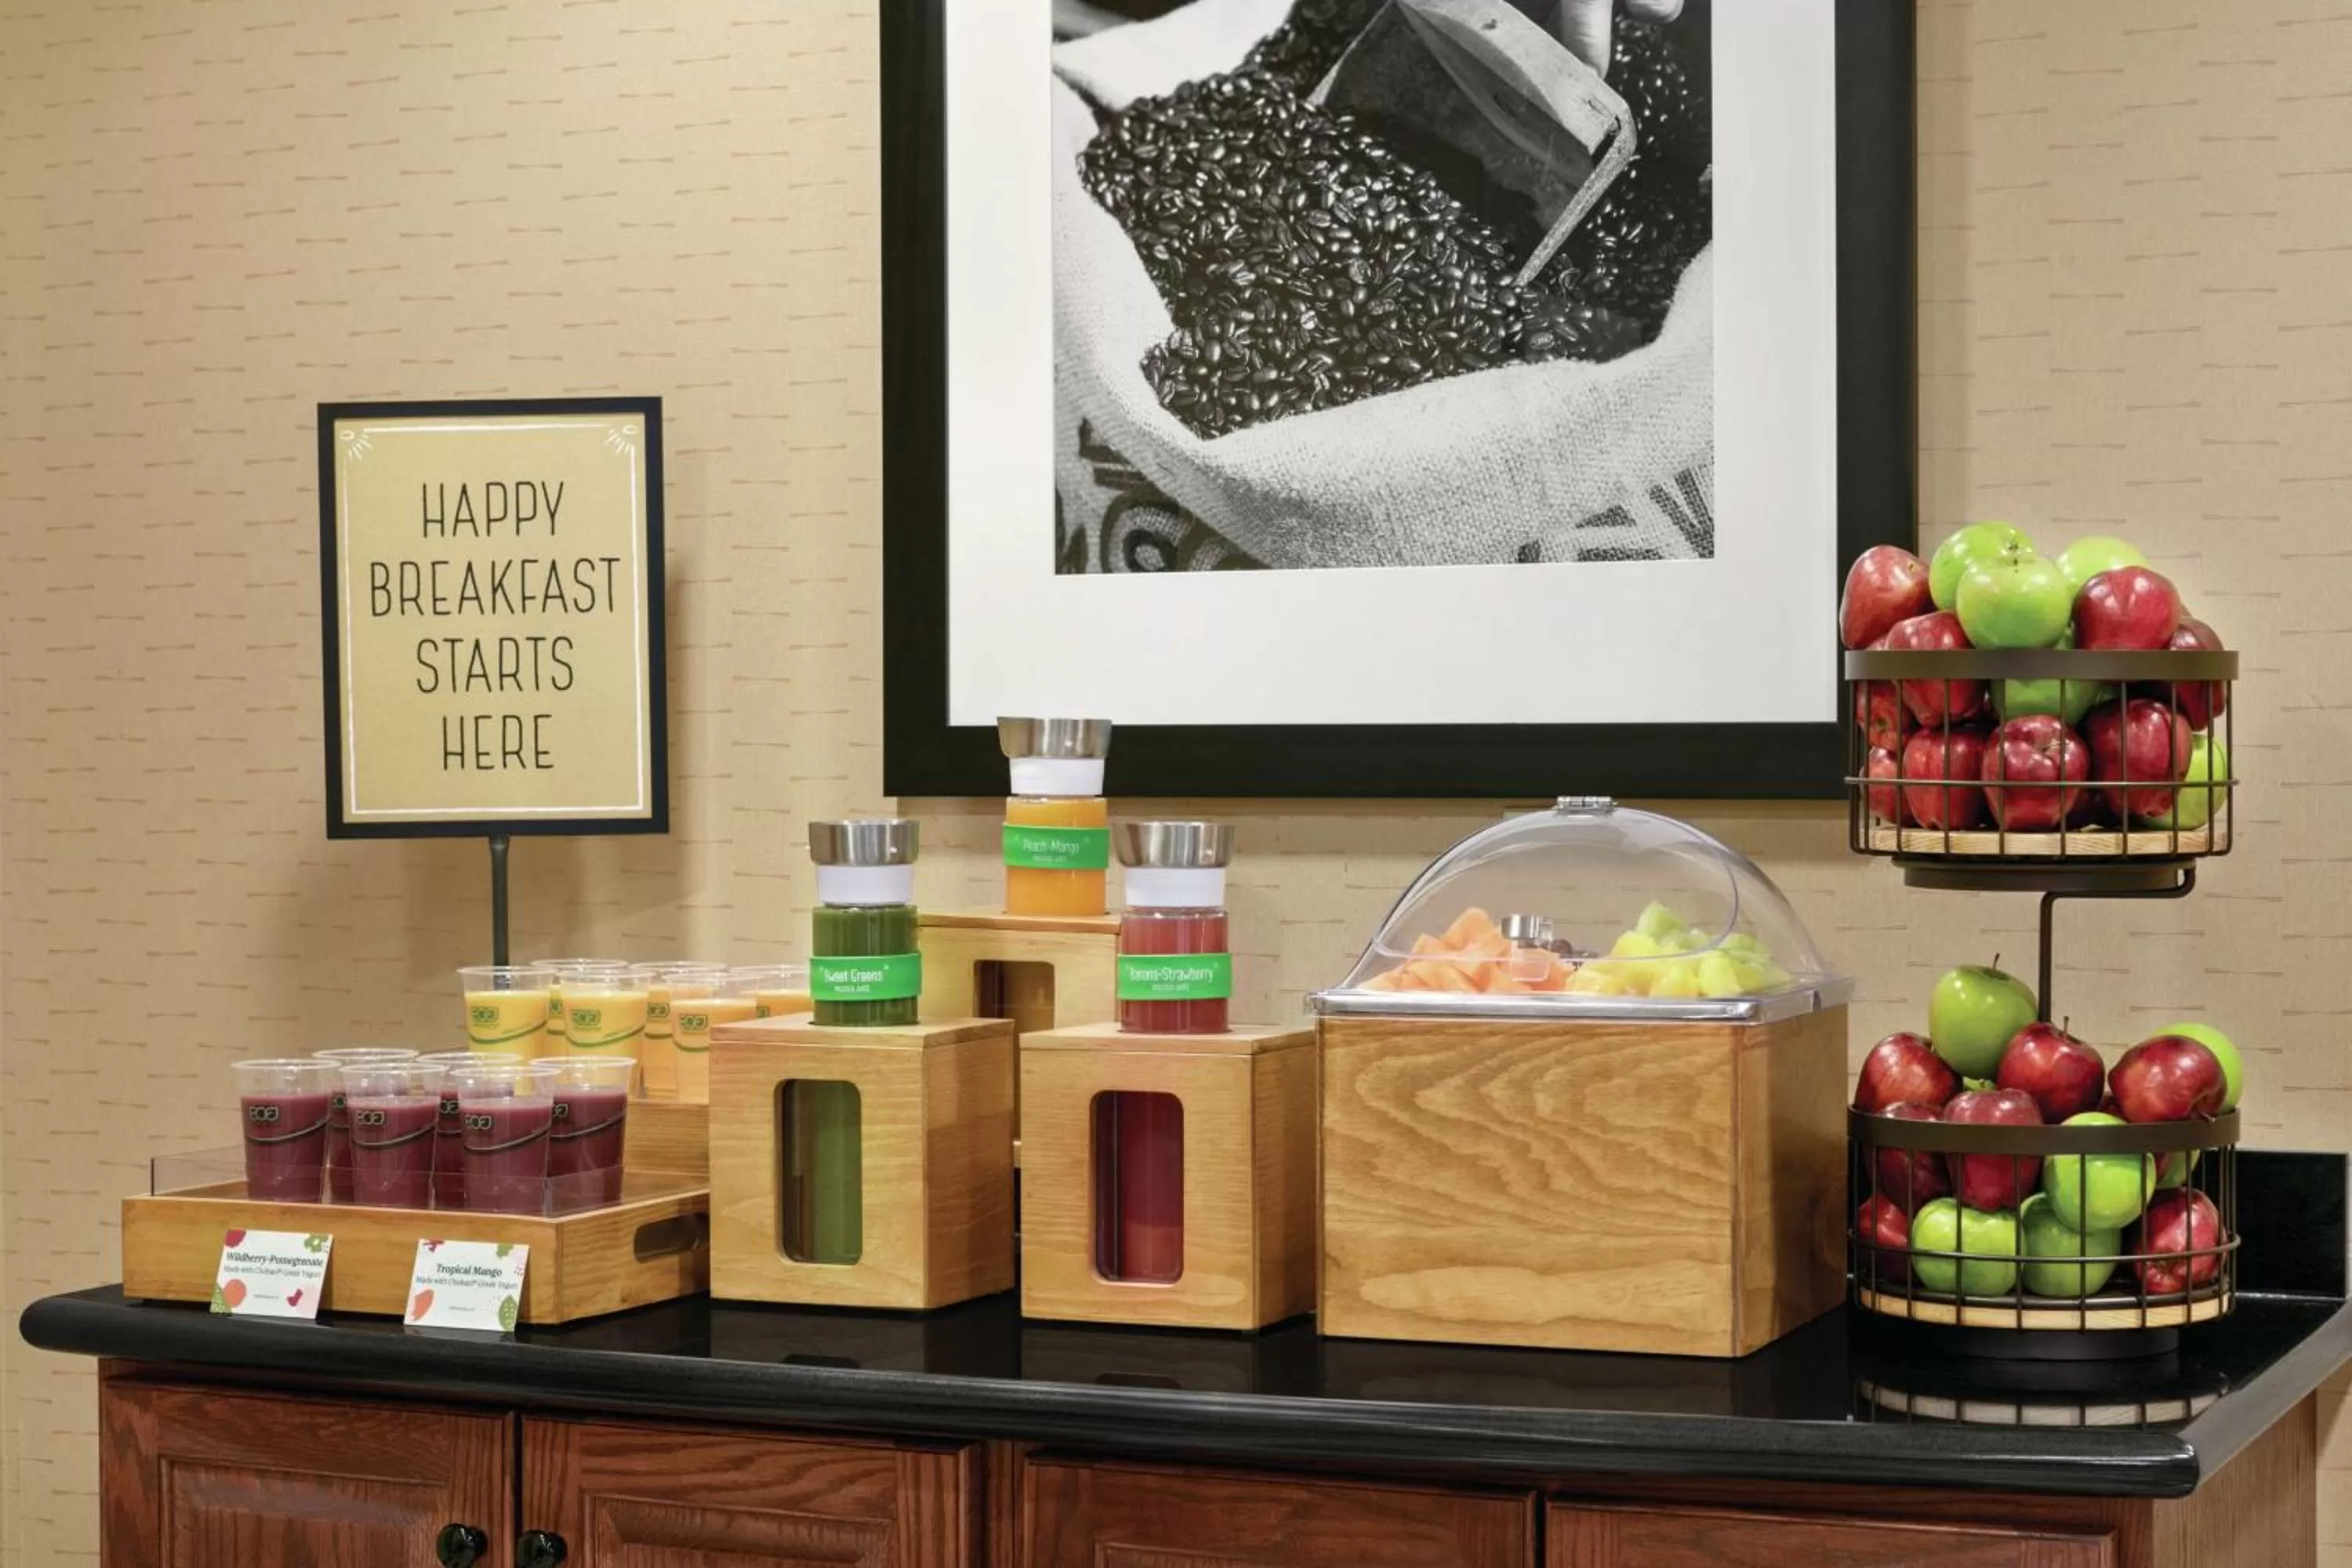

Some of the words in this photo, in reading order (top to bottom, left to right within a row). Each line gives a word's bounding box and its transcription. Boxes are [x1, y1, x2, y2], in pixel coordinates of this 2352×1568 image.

[422, 480, 564, 539] HAPPY
[370, 557, 621, 617] BREAKFAST
[416, 635, 575, 694] STARTS
[442, 714, 555, 771] HERE
[824, 969, 848, 982] Sweet
[851, 968, 884, 982] Greens
[436, 1262, 472, 1276] Tropical
[473, 1266, 503, 1278] Mango
